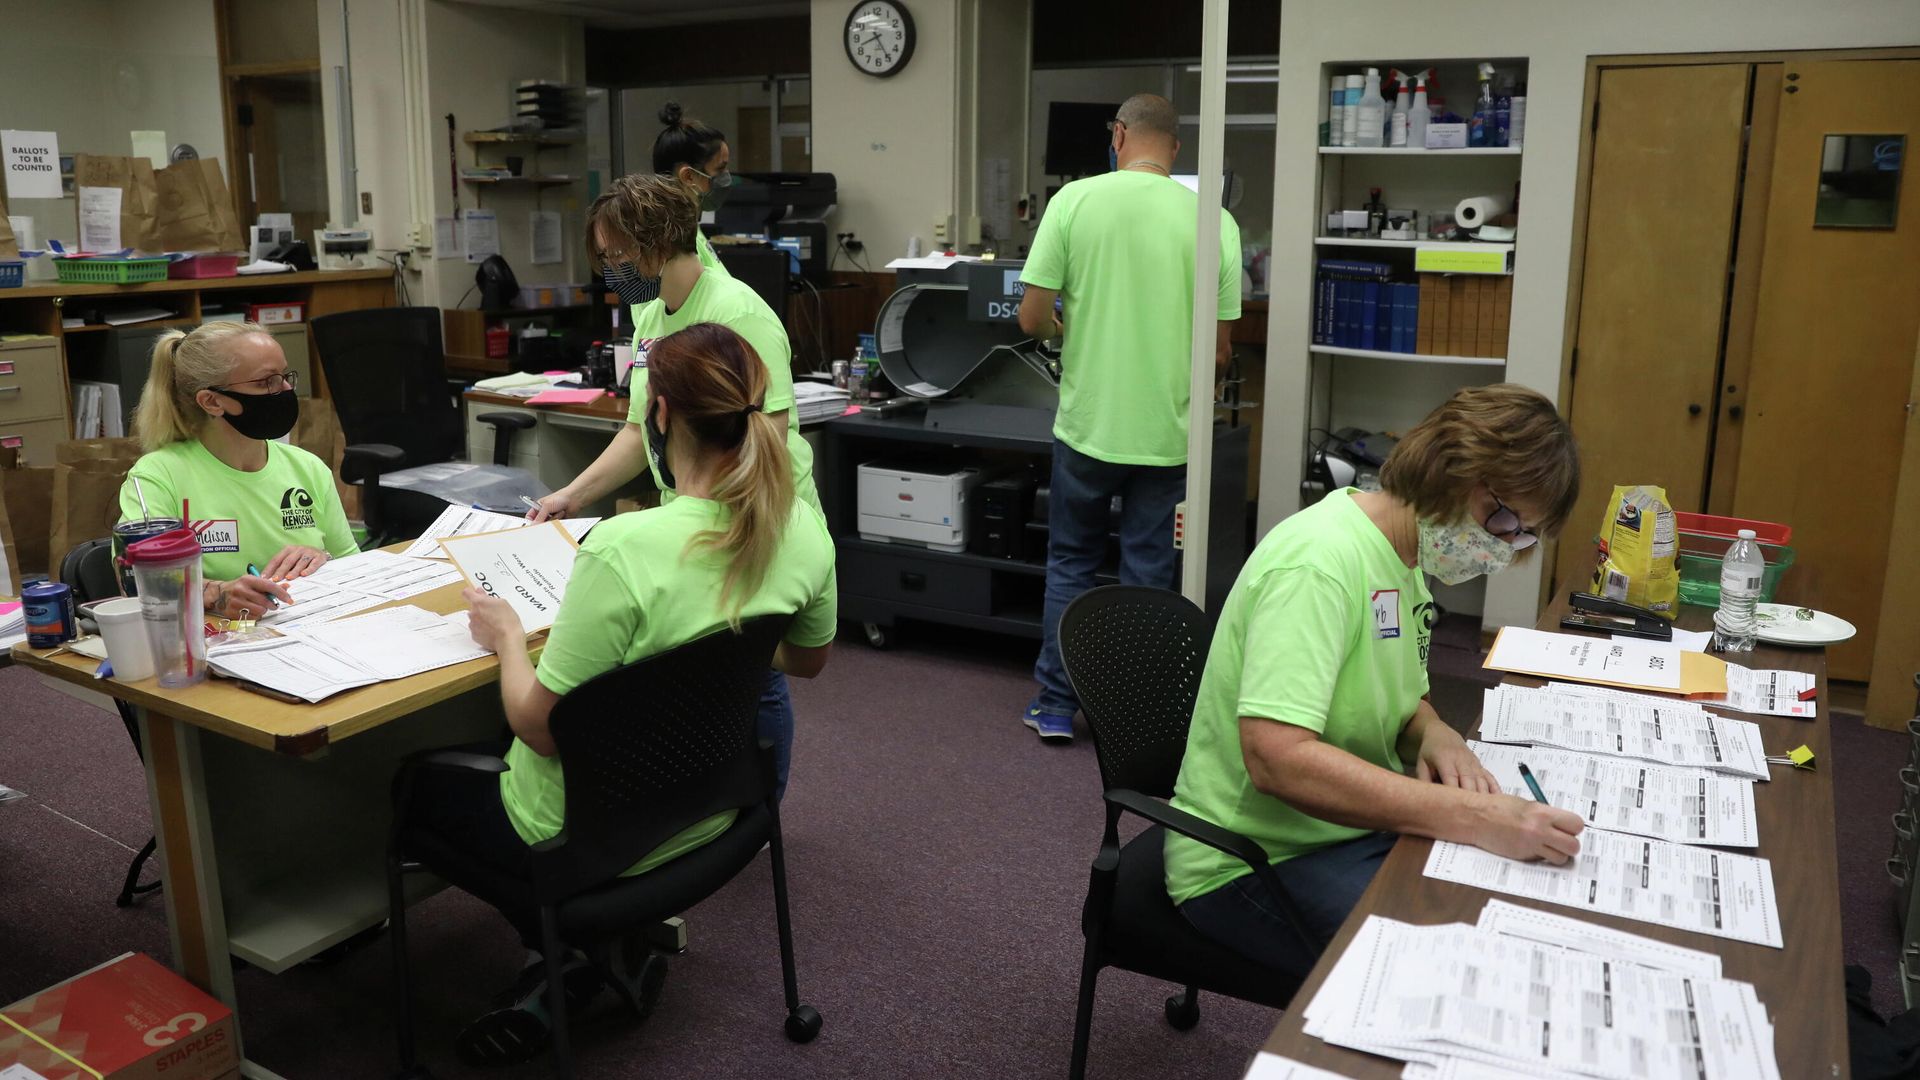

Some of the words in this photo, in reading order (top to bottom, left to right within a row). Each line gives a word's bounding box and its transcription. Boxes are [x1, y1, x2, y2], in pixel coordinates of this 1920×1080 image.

[873, 7, 882, 16] 12
[892, 19, 899, 28] 2
[853, 34, 861, 43] 9
[896, 31, 902, 40] 3
[857, 46, 864, 56] 8
[892, 44, 899, 53] 4
[865, 55, 872, 64] 7
[885, 53, 892, 62] 5
[875, 58, 882, 67] 6
[12, 147, 49, 155] BALLOTS
[19, 155, 31, 163] TO
[282, 514, 315, 527] KENOSHA
[195, 530, 232, 544] Melissa
[512, 553, 526, 569] Were
[525, 569, 543, 587] Which
[533, 568, 556, 590] Remade
[475, 572, 501, 599] BOC
[515, 585, 547, 611] WARD
[143, 1012, 207, 1047] 3
[156, 1028, 225, 1072] STAPLES
